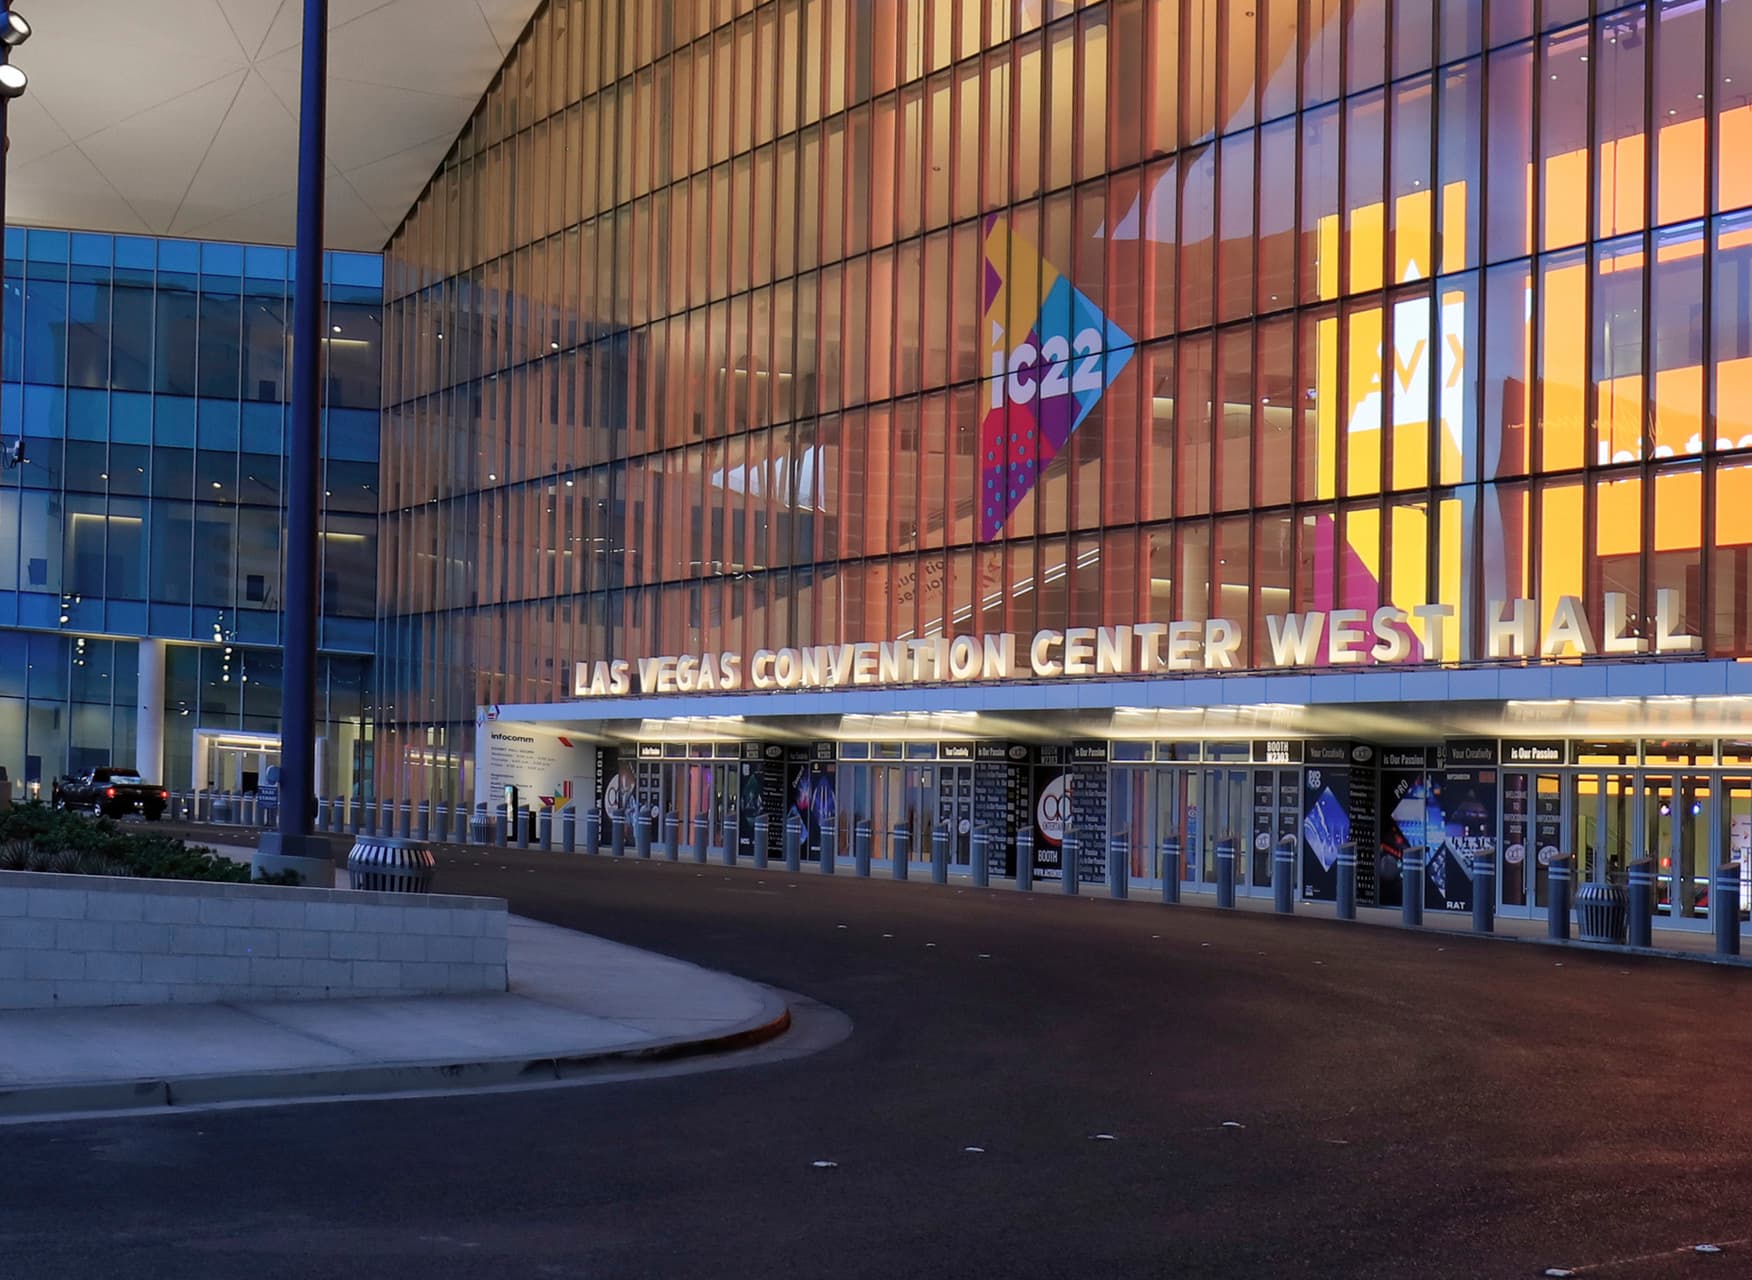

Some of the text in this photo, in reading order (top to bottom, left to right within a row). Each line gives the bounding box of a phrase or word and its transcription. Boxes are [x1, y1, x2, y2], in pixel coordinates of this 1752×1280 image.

[575, 587, 1703, 696] LAS VEGAS CONVENTION CENTER WEST HALL
[1266, 741, 1289, 752] BOOTH
[1518, 747, 1531, 760] Our
[1532, 747, 1559, 760] Passion
[1038, 849, 1058, 863] BOOTH
